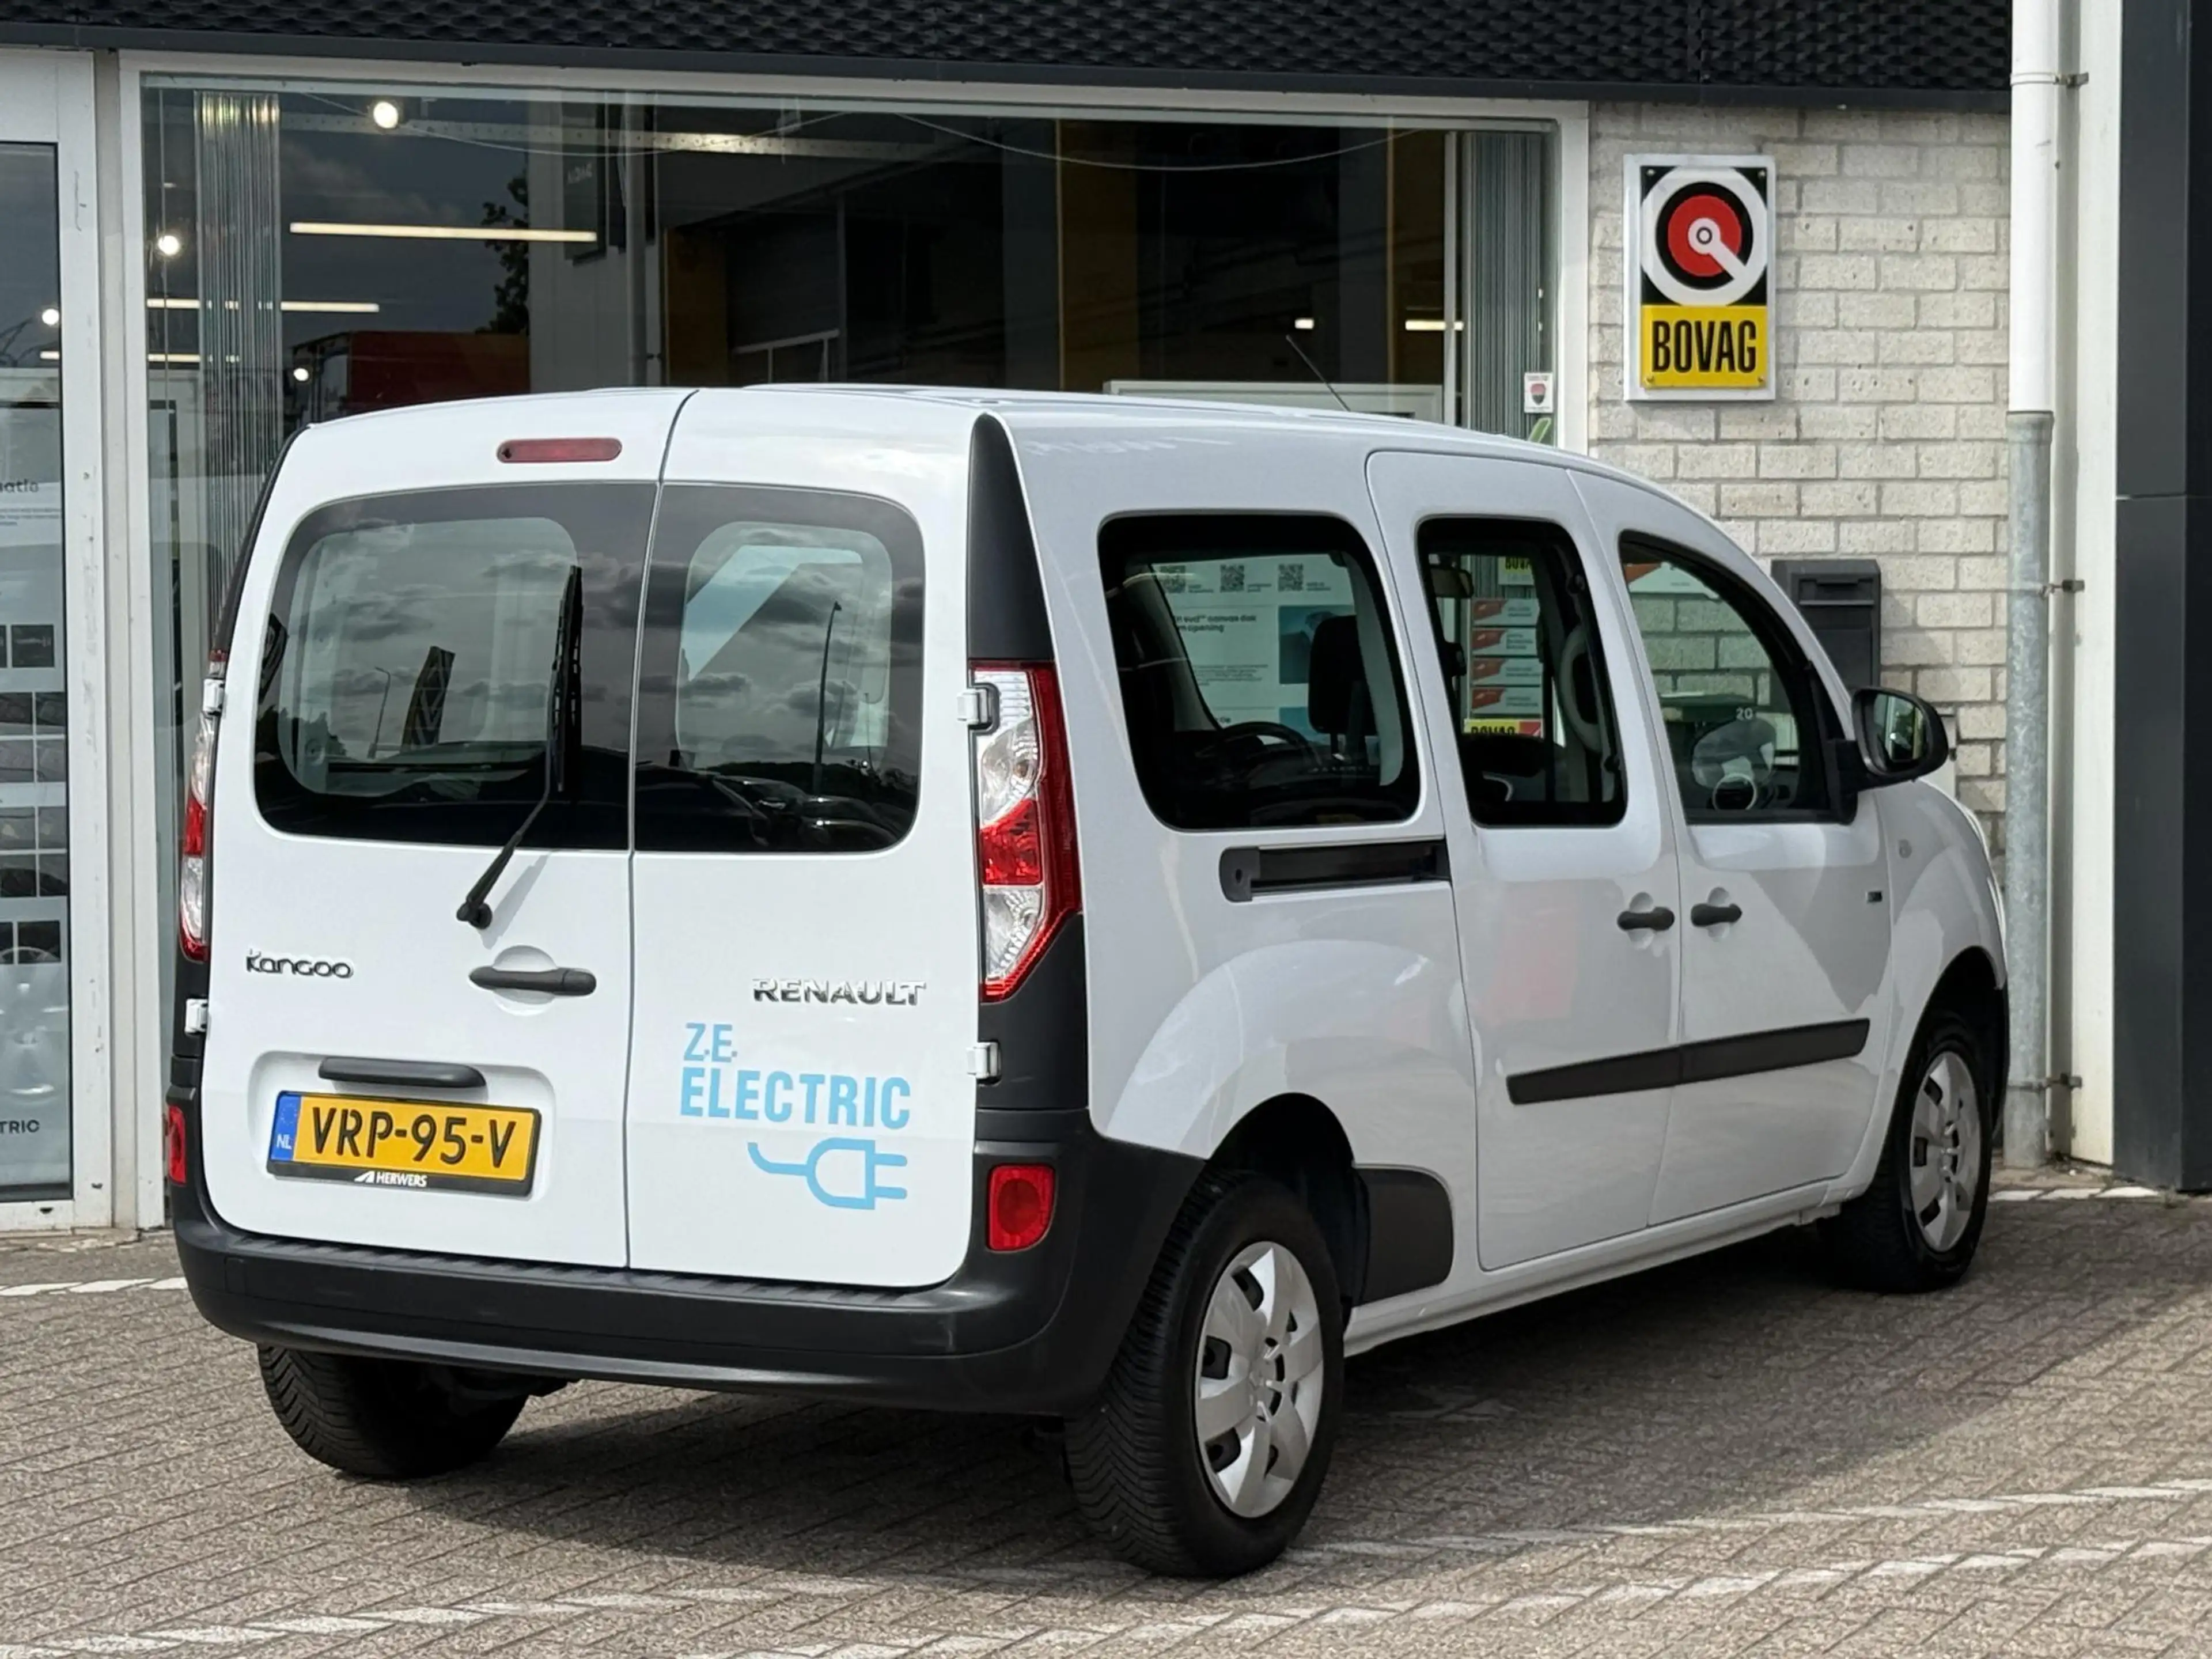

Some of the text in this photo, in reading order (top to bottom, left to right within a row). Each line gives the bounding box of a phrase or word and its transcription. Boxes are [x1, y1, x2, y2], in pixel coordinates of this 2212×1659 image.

[1652, 320, 1756, 373] BOVAG
[752, 978, 926, 1006] RENAULT
[683, 1022, 737, 1063] Z.E.
[680, 1066, 911, 1130] ELECTRIC
[276, 1133, 292, 1149] NL
[312, 1106, 516, 1168] VRP-95-V
[376, 1171, 427, 1187] HERWERS
